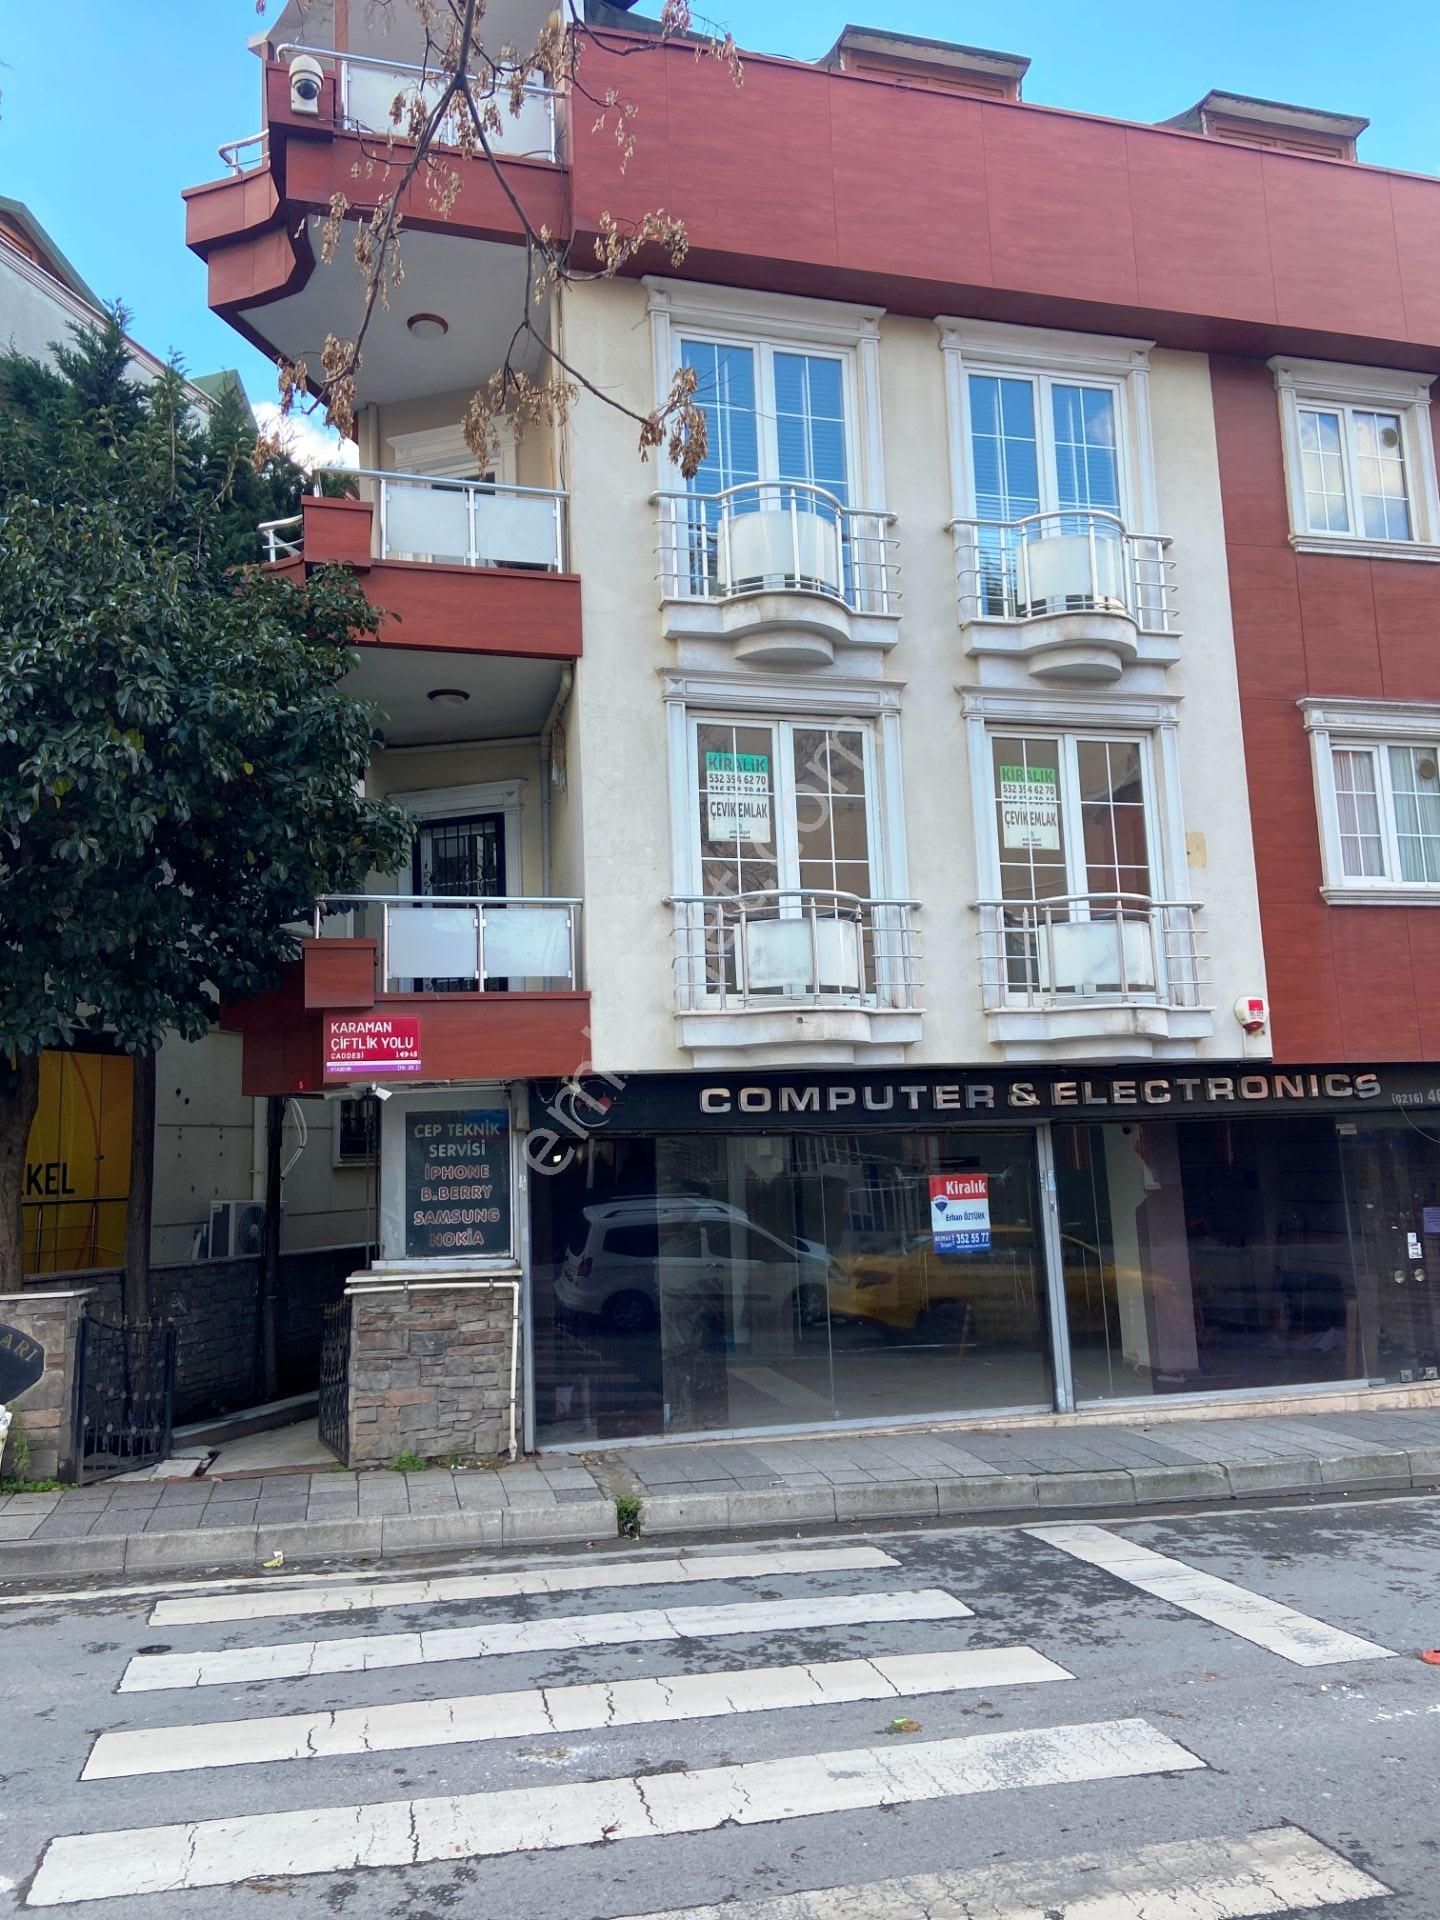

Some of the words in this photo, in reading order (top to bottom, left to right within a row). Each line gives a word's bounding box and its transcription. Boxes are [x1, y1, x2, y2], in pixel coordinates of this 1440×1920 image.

[709, 774, 725, 784] 532
[744, 775, 754, 784] 62
[756, 776, 767, 785] 70
[1003, 784, 1017, 793] 532
[1034, 785, 1044, 794] 62
[1045, 786, 1055, 795] 70
[710, 799, 737, 820] ÇEVİK
[738, 802, 768, 818] EMLAK
[1004, 808, 1029, 828] ÇEVİK
[1030, 812, 1056, 827] EMLAK
[330, 1021, 392, 1034] KARAMAN
[330, 1035, 378, 1052] ÇİFTLİK
[381, 1036, 414, 1049] YOLU
[699, 1084, 995, 1114] COMPUTER
[1008, 1082, 1041, 1107] &
[1050, 1073, 1382, 1106] ELECTRONICS
[1392, 1092, 1424, 1113] (0216)
[447, 1119, 500, 1137] TEKNİK
[428, 1140, 486, 1158] SERVİSİ
[424, 1163, 490, 1180] İPHONE
[420, 1184, 493, 1201] B.BERRY
[946, 1180, 986, 1195] Kiralık
[413, 1208, 501, 1226] SAMSUNG
[429, 1228, 485, 1247] NOKİA
[956, 1233, 970, 1244] 352
